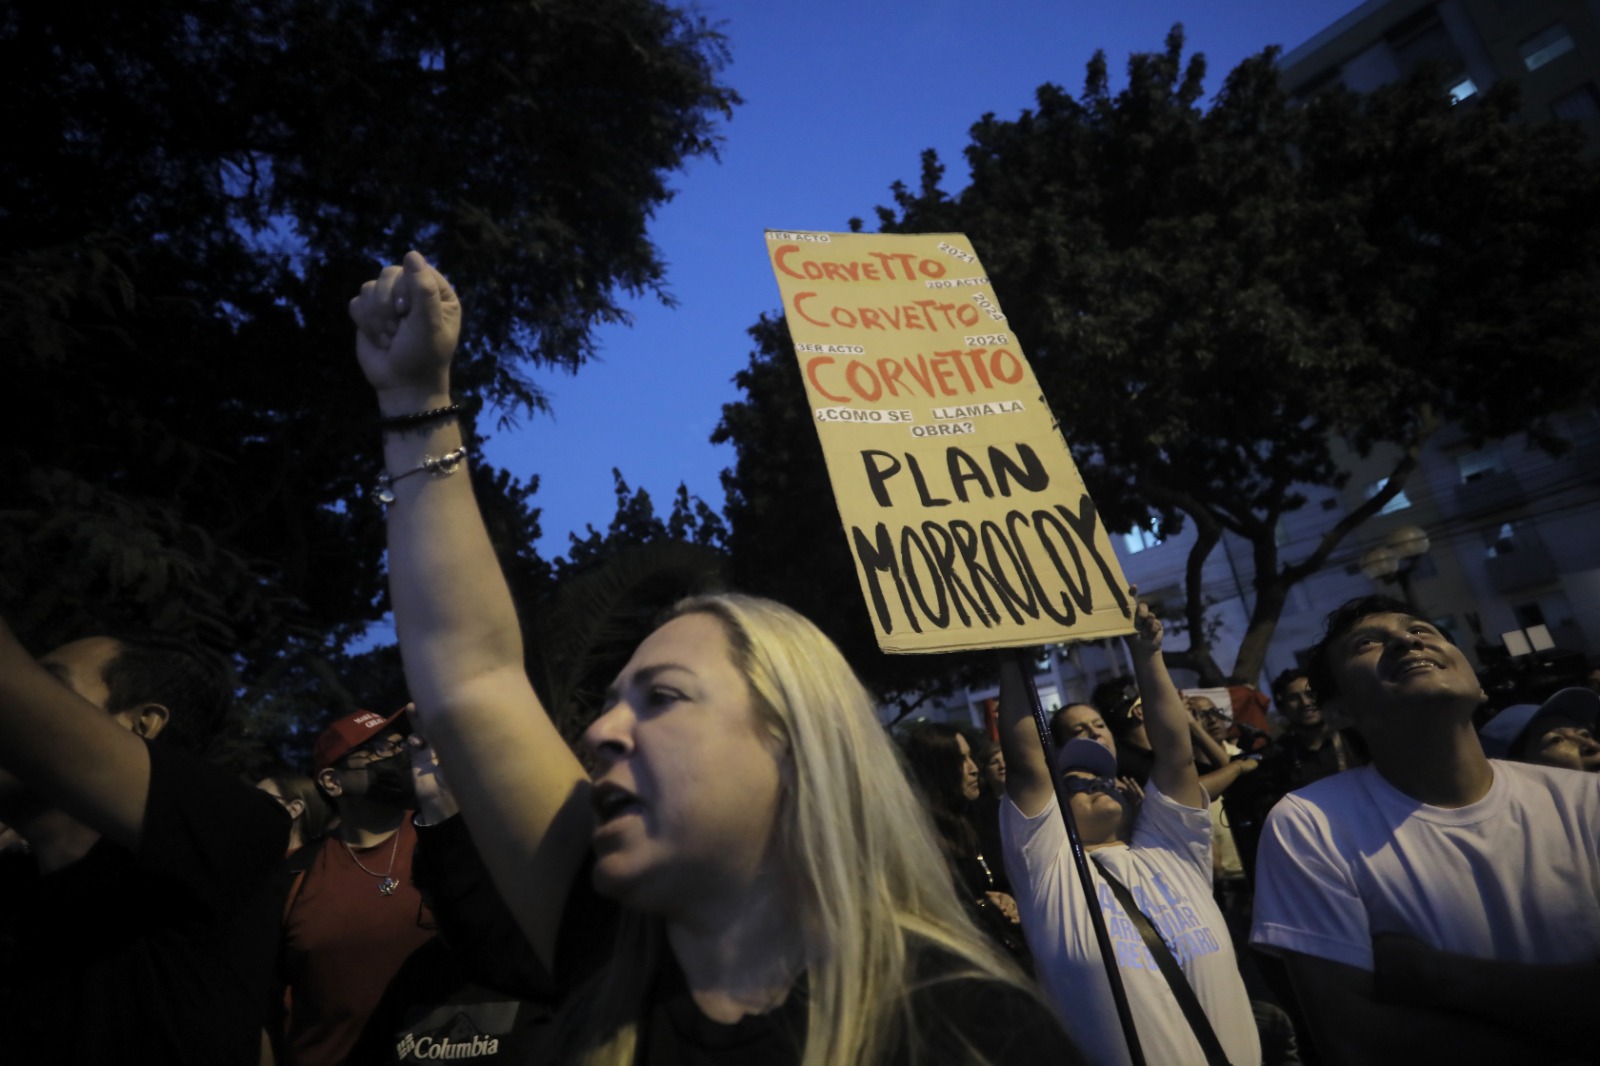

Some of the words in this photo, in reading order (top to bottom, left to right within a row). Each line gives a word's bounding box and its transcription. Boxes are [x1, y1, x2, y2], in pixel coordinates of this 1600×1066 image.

[796, 233, 829, 242] ACTO
[774, 244, 947, 282] CORVETTO
[939, 243, 975, 264] 2021
[927, 280, 952, 289] 2DO
[956, 277, 989, 287] ACTO
[793, 291, 980, 332] CORVETTO
[972, 293, 1004, 321] 2024
[797, 342, 824, 352] 3ER
[828, 344, 865, 354] ACTO
[966, 334, 1009, 347] 2026
[806, 348, 1024, 403] CORVETTO
[887, 410, 912, 422] SE
[931, 404, 995, 420] LLAMA
[998, 401, 1024, 413] LA
[911, 422, 974, 438] OBRA?
[860, 442, 1050, 507] PLAN
[851, 493, 1132, 635] MORROCOY
[413, 1034, 499, 1060] Columbia
